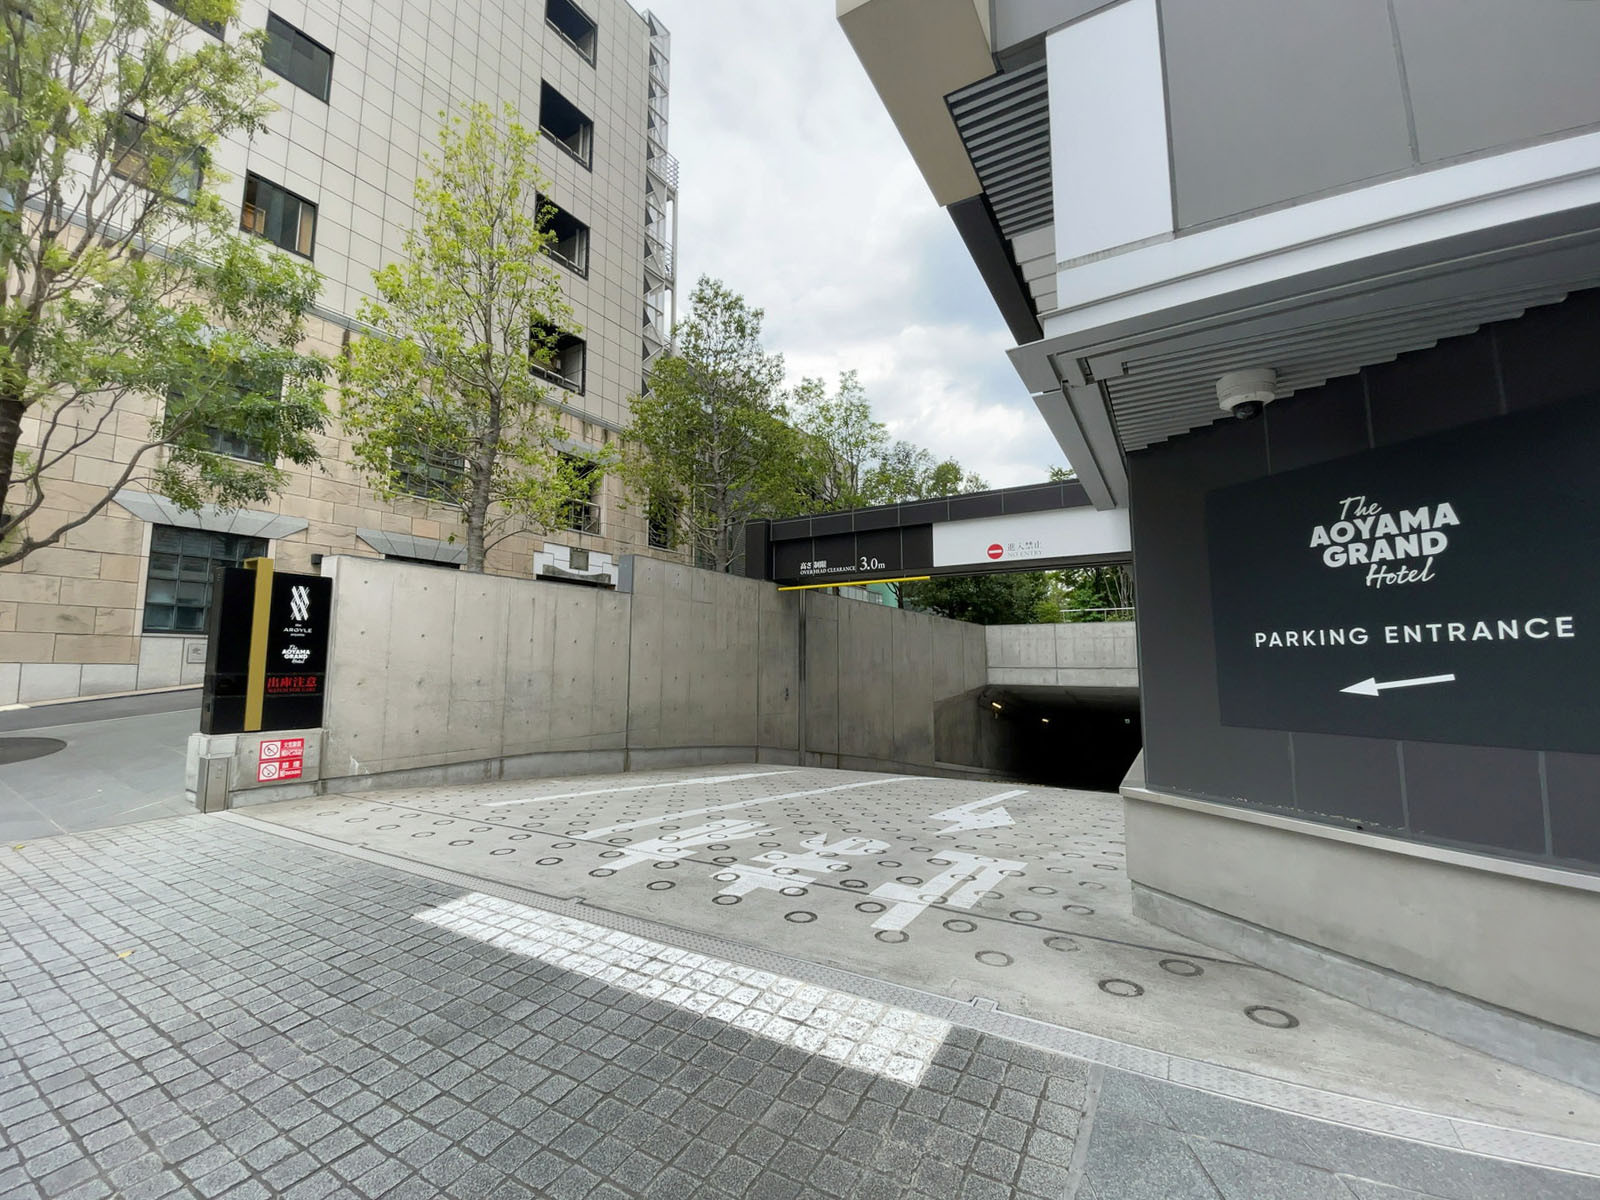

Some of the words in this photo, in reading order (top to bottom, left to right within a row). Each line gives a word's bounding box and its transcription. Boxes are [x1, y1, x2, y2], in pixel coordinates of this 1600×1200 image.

[1339, 496, 1382, 520] The
[1309, 502, 1460, 548] AOYAMA
[859, 556, 886, 571] 3.0m
[1322, 530, 1448, 568] GRAND
[1365, 557, 1435, 588] Hotel
[1255, 626, 1369, 648] PARKING
[1384, 616, 1575, 645] ENTRANCE
